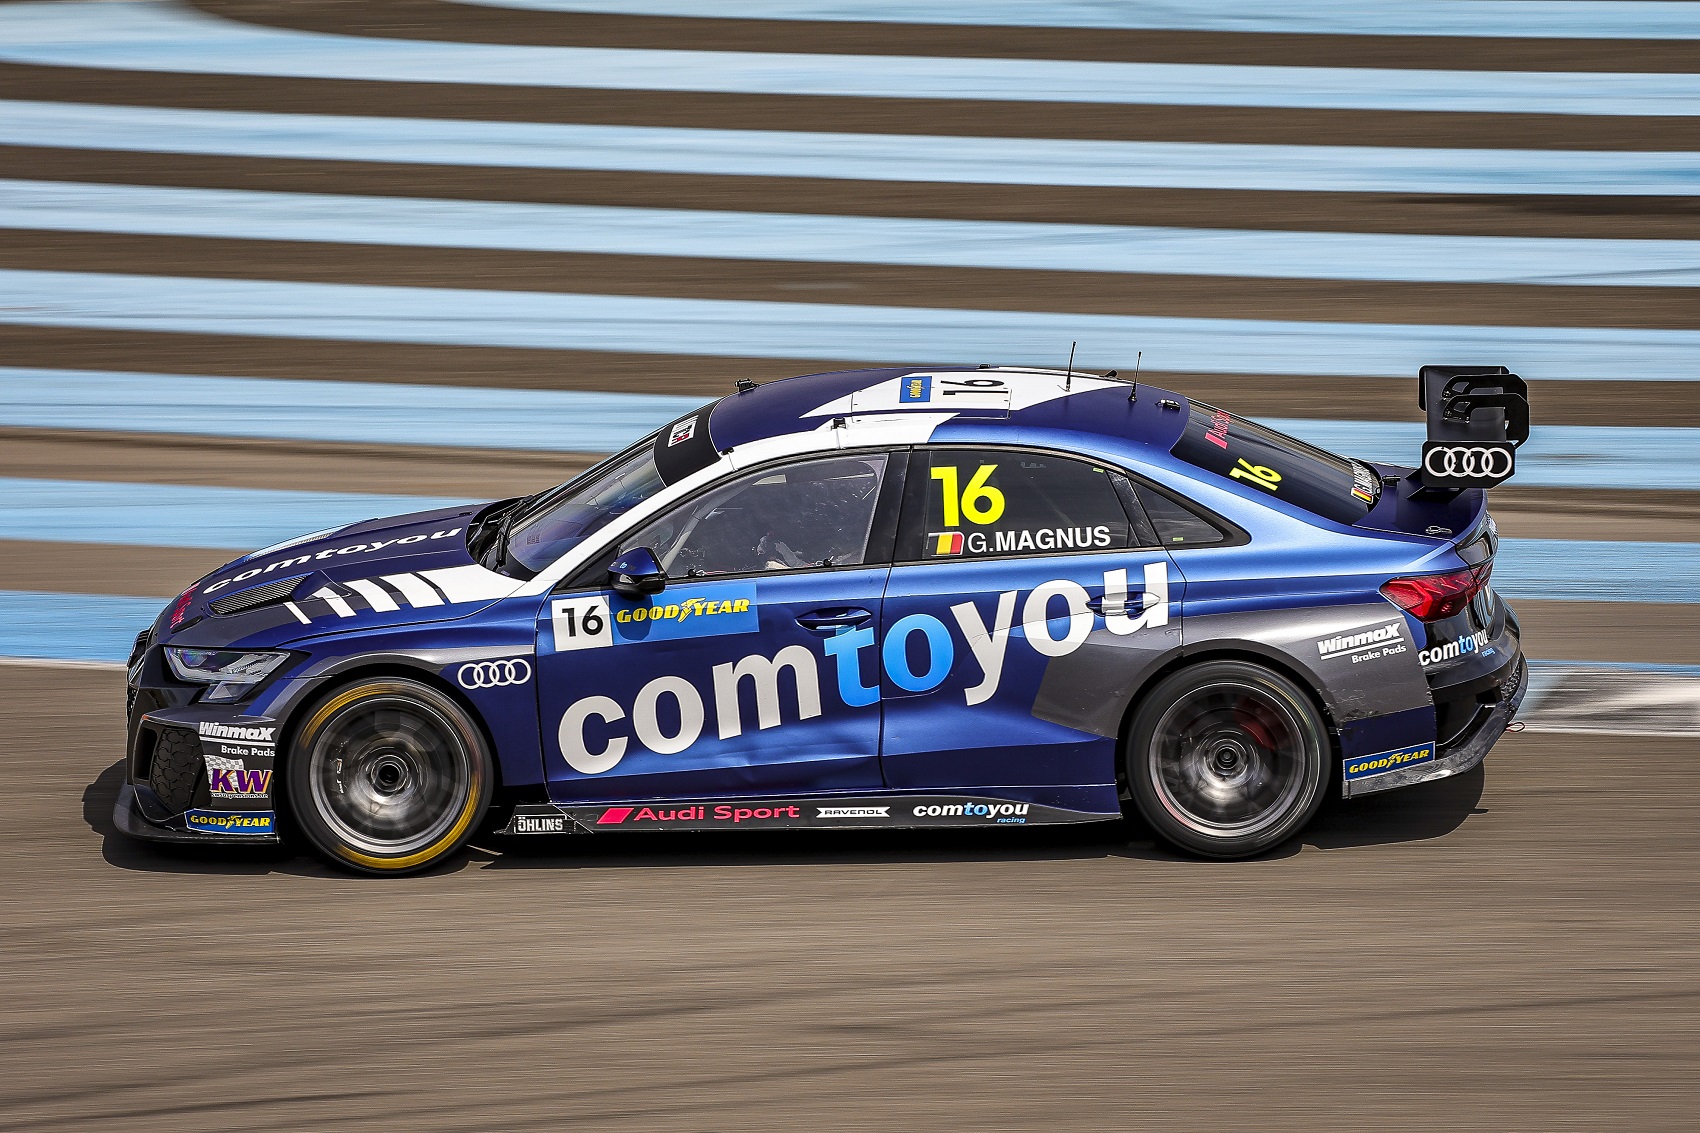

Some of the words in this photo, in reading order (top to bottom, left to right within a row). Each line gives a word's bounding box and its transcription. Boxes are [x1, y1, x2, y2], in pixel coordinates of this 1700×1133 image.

[939, 379, 1008, 396] 16
[1229, 458, 1283, 491] 16
[930, 464, 1005, 527] 16
[968, 525, 1111, 554] G.MAGNUS
[203, 527, 462, 594] comtoyou
[562, 605, 602, 638] 16
[616, 596, 750, 625] GOODYEAR
[1352, 651, 1381, 664] Brake
[1383, 644, 1407, 656] Pads
[1418, 629, 1488, 666] comtoyou
[557, 562, 1169, 775] comtoyou
[221, 745, 249, 757] Brake
[251, 746, 276, 757] Pads
[1349, 749, 1430, 774] GOODYEAR
[210, 768, 273, 794] KW
[190, 814, 271, 830] GOODYEAR
[633, 806, 704, 821] Audi
[713, 805, 800, 823] Sport
[824, 808, 883, 816] RAVENOL
[912, 802, 1029, 818] comtoyou
[517, 816, 564, 832] ÖHLINS
